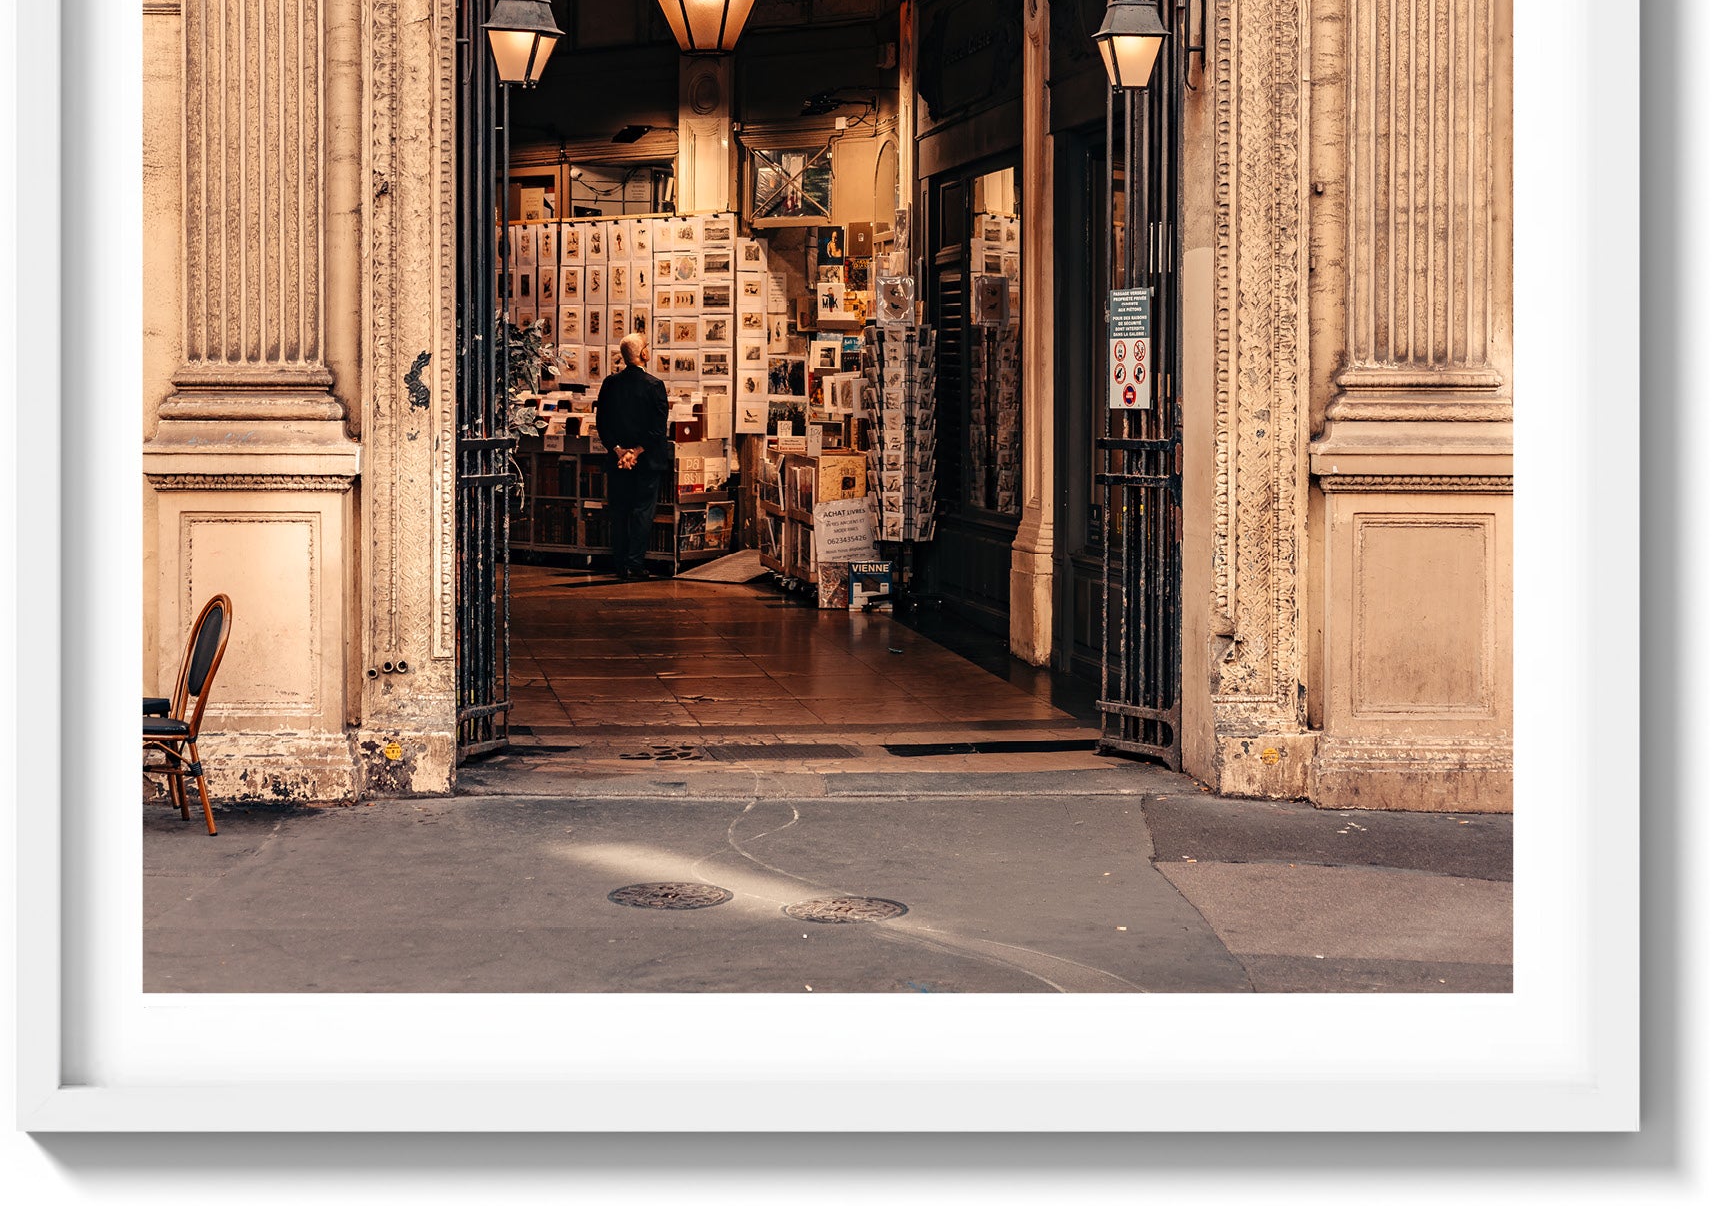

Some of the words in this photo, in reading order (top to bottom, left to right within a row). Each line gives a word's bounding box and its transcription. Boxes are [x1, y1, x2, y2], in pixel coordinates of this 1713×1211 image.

[823, 509, 846, 518] ACHAT
[846, 508, 866, 516] LIVRES
[852, 563, 890, 572] VIENNE
